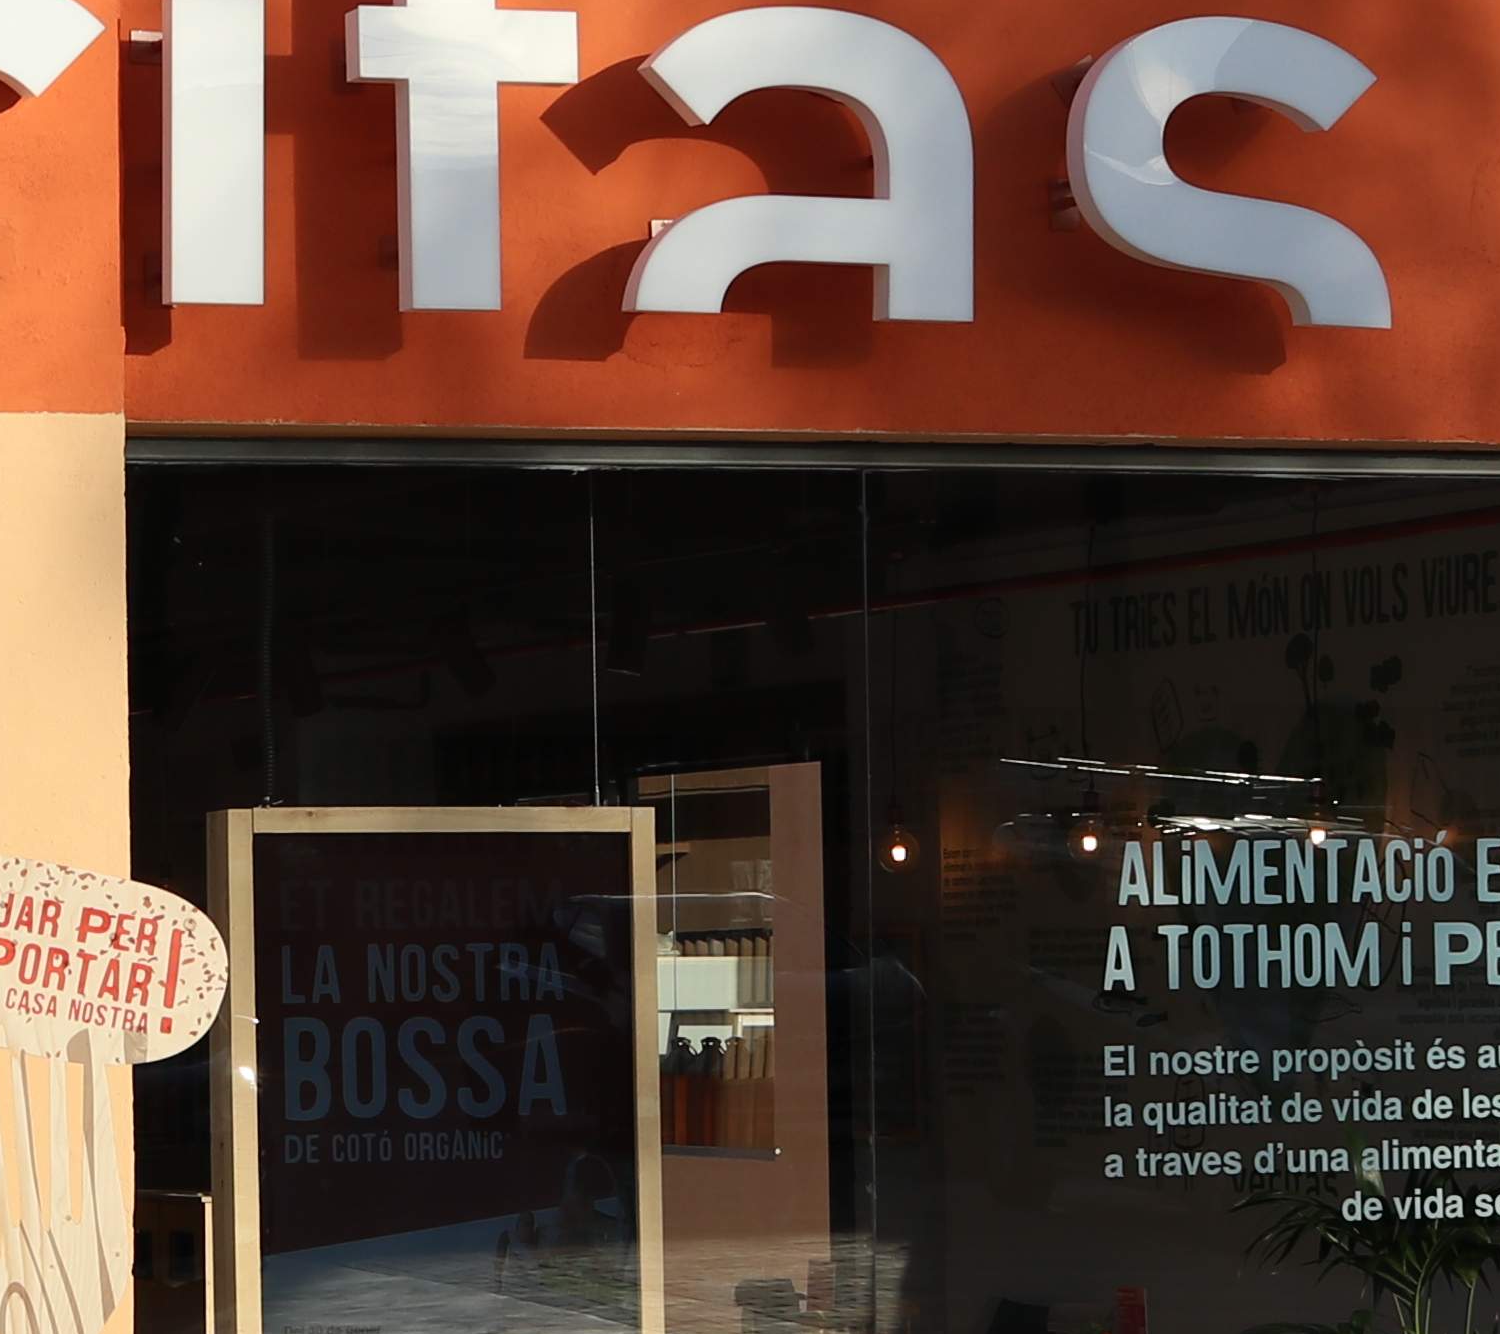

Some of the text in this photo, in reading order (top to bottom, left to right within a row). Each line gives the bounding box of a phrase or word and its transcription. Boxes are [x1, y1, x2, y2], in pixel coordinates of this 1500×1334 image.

[77, 907, 158, 955] PER
[281, 942, 567, 1004] LA NOSTRA
[1103, 923, 1136, 992] A
[1157, 923, 1380, 991] TOTHOM
[5, 987, 57, 1018] CASA
[68, 999, 148, 1034] NOSTRA
[283, 1013, 569, 1122] BOSSA
[1104, 1045, 1137, 1078] El
[1149, 1043, 1261, 1078] nostre
[1271, 1039, 1416, 1081] propòsit
[1425, 1036, 1467, 1071] és
[1104, 1095, 1133, 1129] la
[1142, 1091, 1273, 1135] qualitat
[1280, 1091, 1324, 1124] de
[1331, 1089, 1403, 1123] vida
[1411, 1087, 1455, 1122] de
[284, 1134, 320, 1164] DE
[1104, 1151, 1126, 1179] a
[1134, 1146, 1243, 1178] traves
[1340, 1187, 1383, 1223] de
[1392, 1185, 1465, 1221] vida
